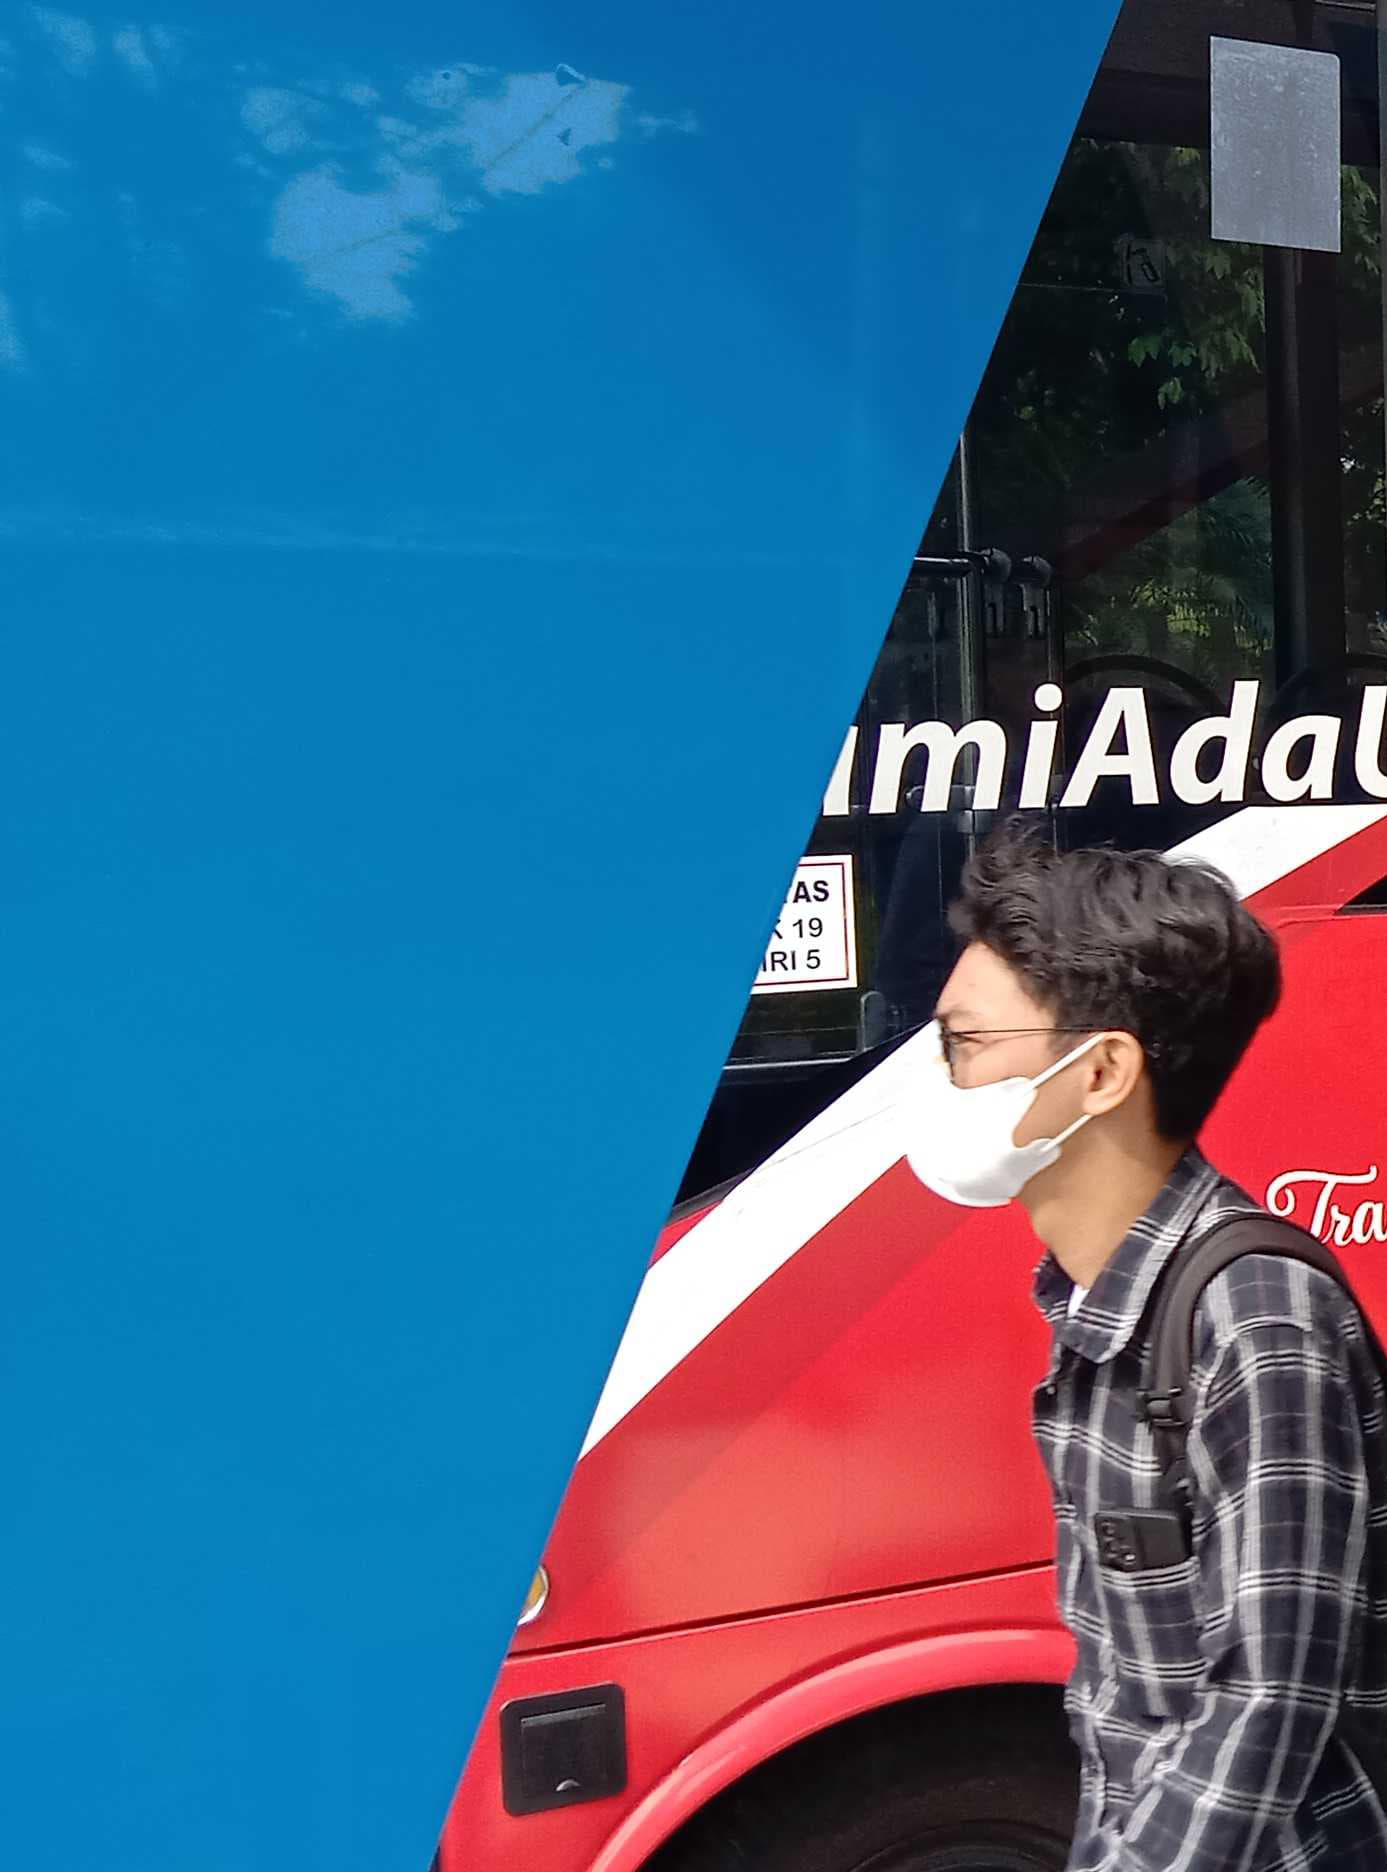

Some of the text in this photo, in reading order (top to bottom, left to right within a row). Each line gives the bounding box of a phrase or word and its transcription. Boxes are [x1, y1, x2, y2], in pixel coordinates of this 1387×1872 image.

[784, 880, 830, 904] AS
[792, 917, 823, 939] 19
[806, 949, 821, 970] 5
